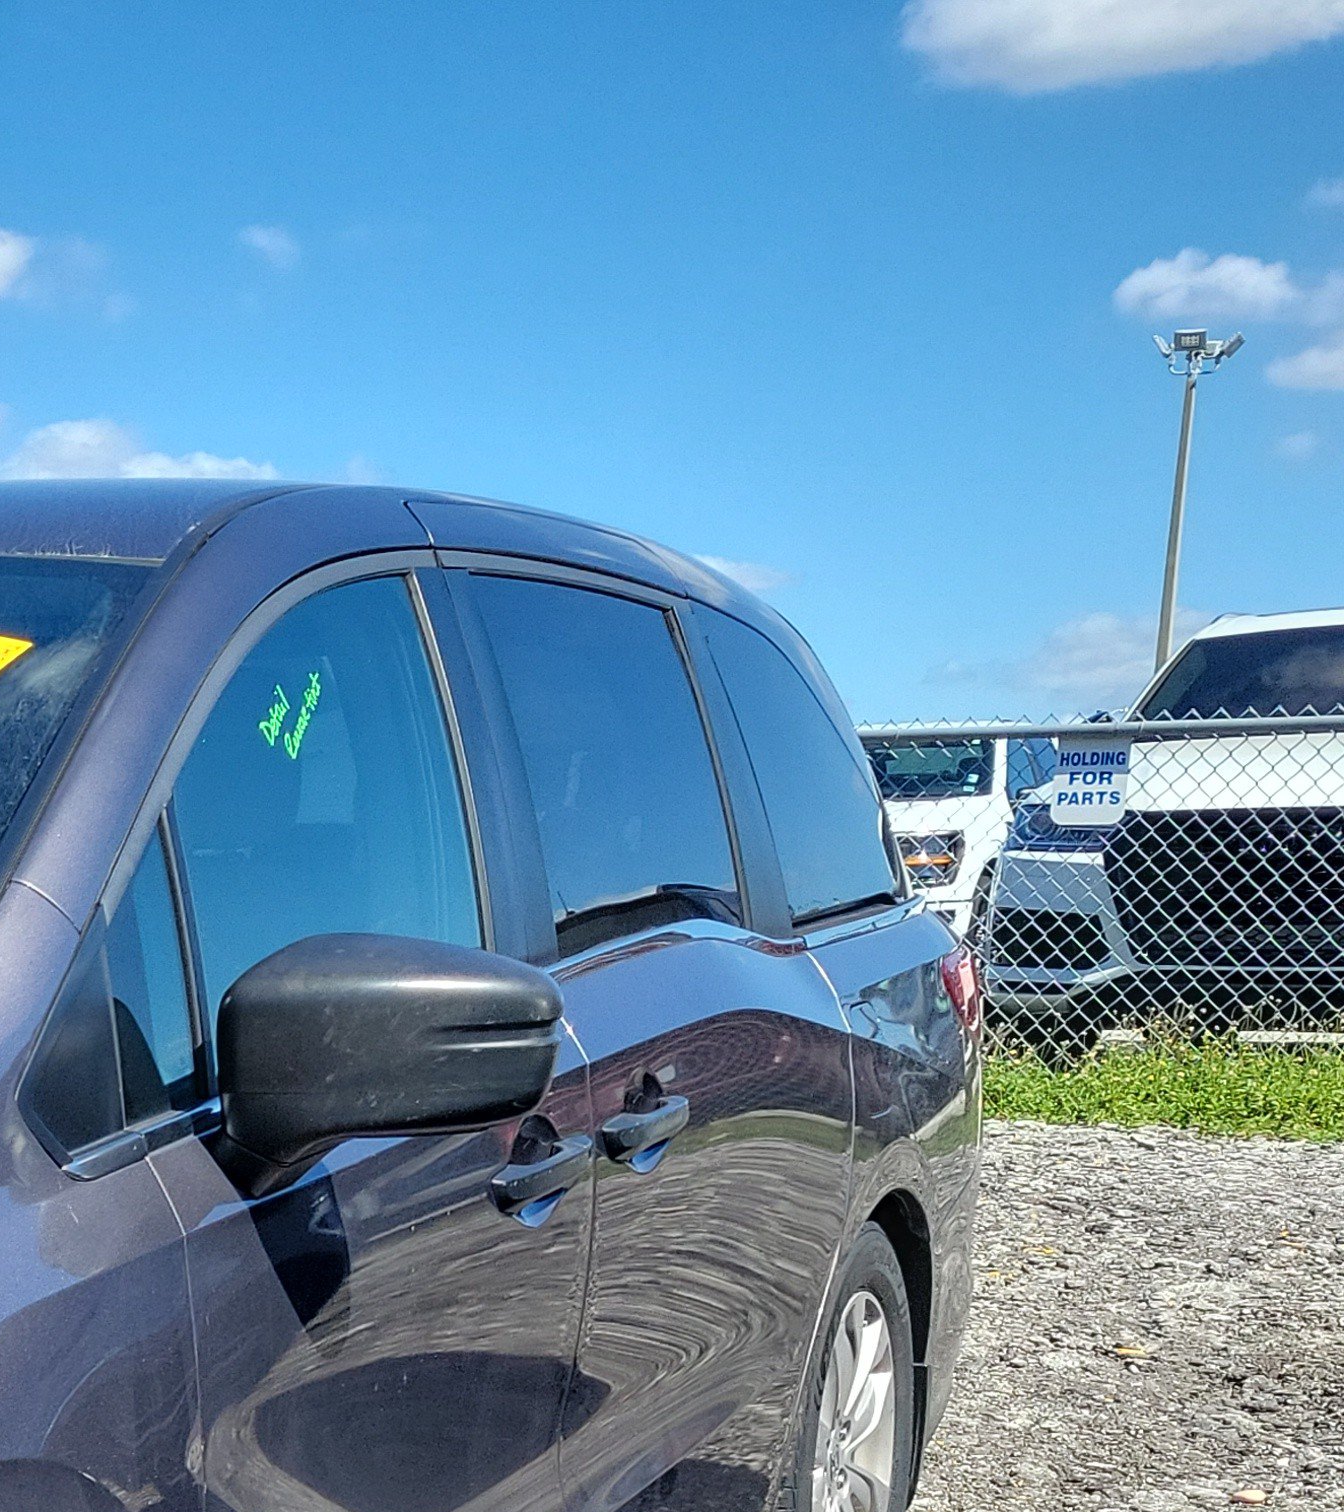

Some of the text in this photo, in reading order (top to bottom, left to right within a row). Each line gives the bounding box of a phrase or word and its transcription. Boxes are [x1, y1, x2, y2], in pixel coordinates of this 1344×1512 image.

[1059, 751, 1127, 767] HOLDING
[1068, 770, 1114, 786] FOR
[1056, 790, 1121, 806] PARTS
